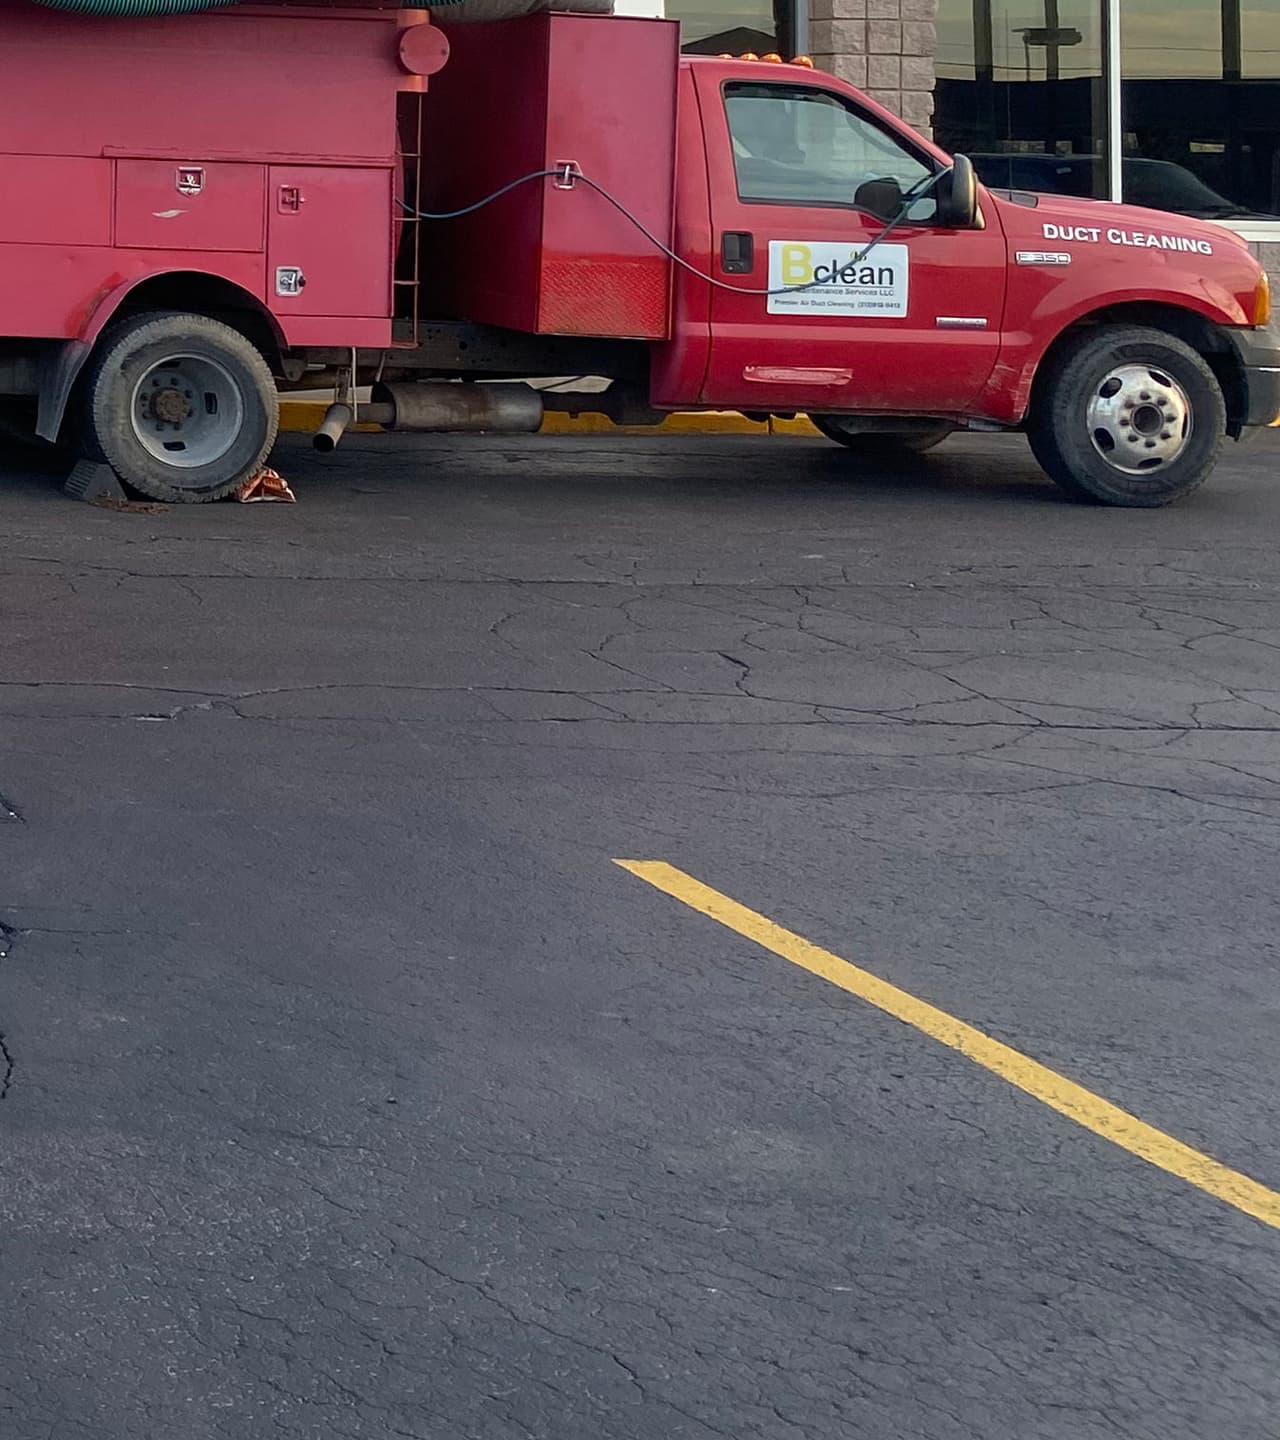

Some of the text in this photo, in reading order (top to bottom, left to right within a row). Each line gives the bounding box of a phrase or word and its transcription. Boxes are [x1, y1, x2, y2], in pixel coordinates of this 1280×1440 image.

[1042, 223, 1213, 256] DUCT CLEANING
[879, 289, 895, 297] LLC
